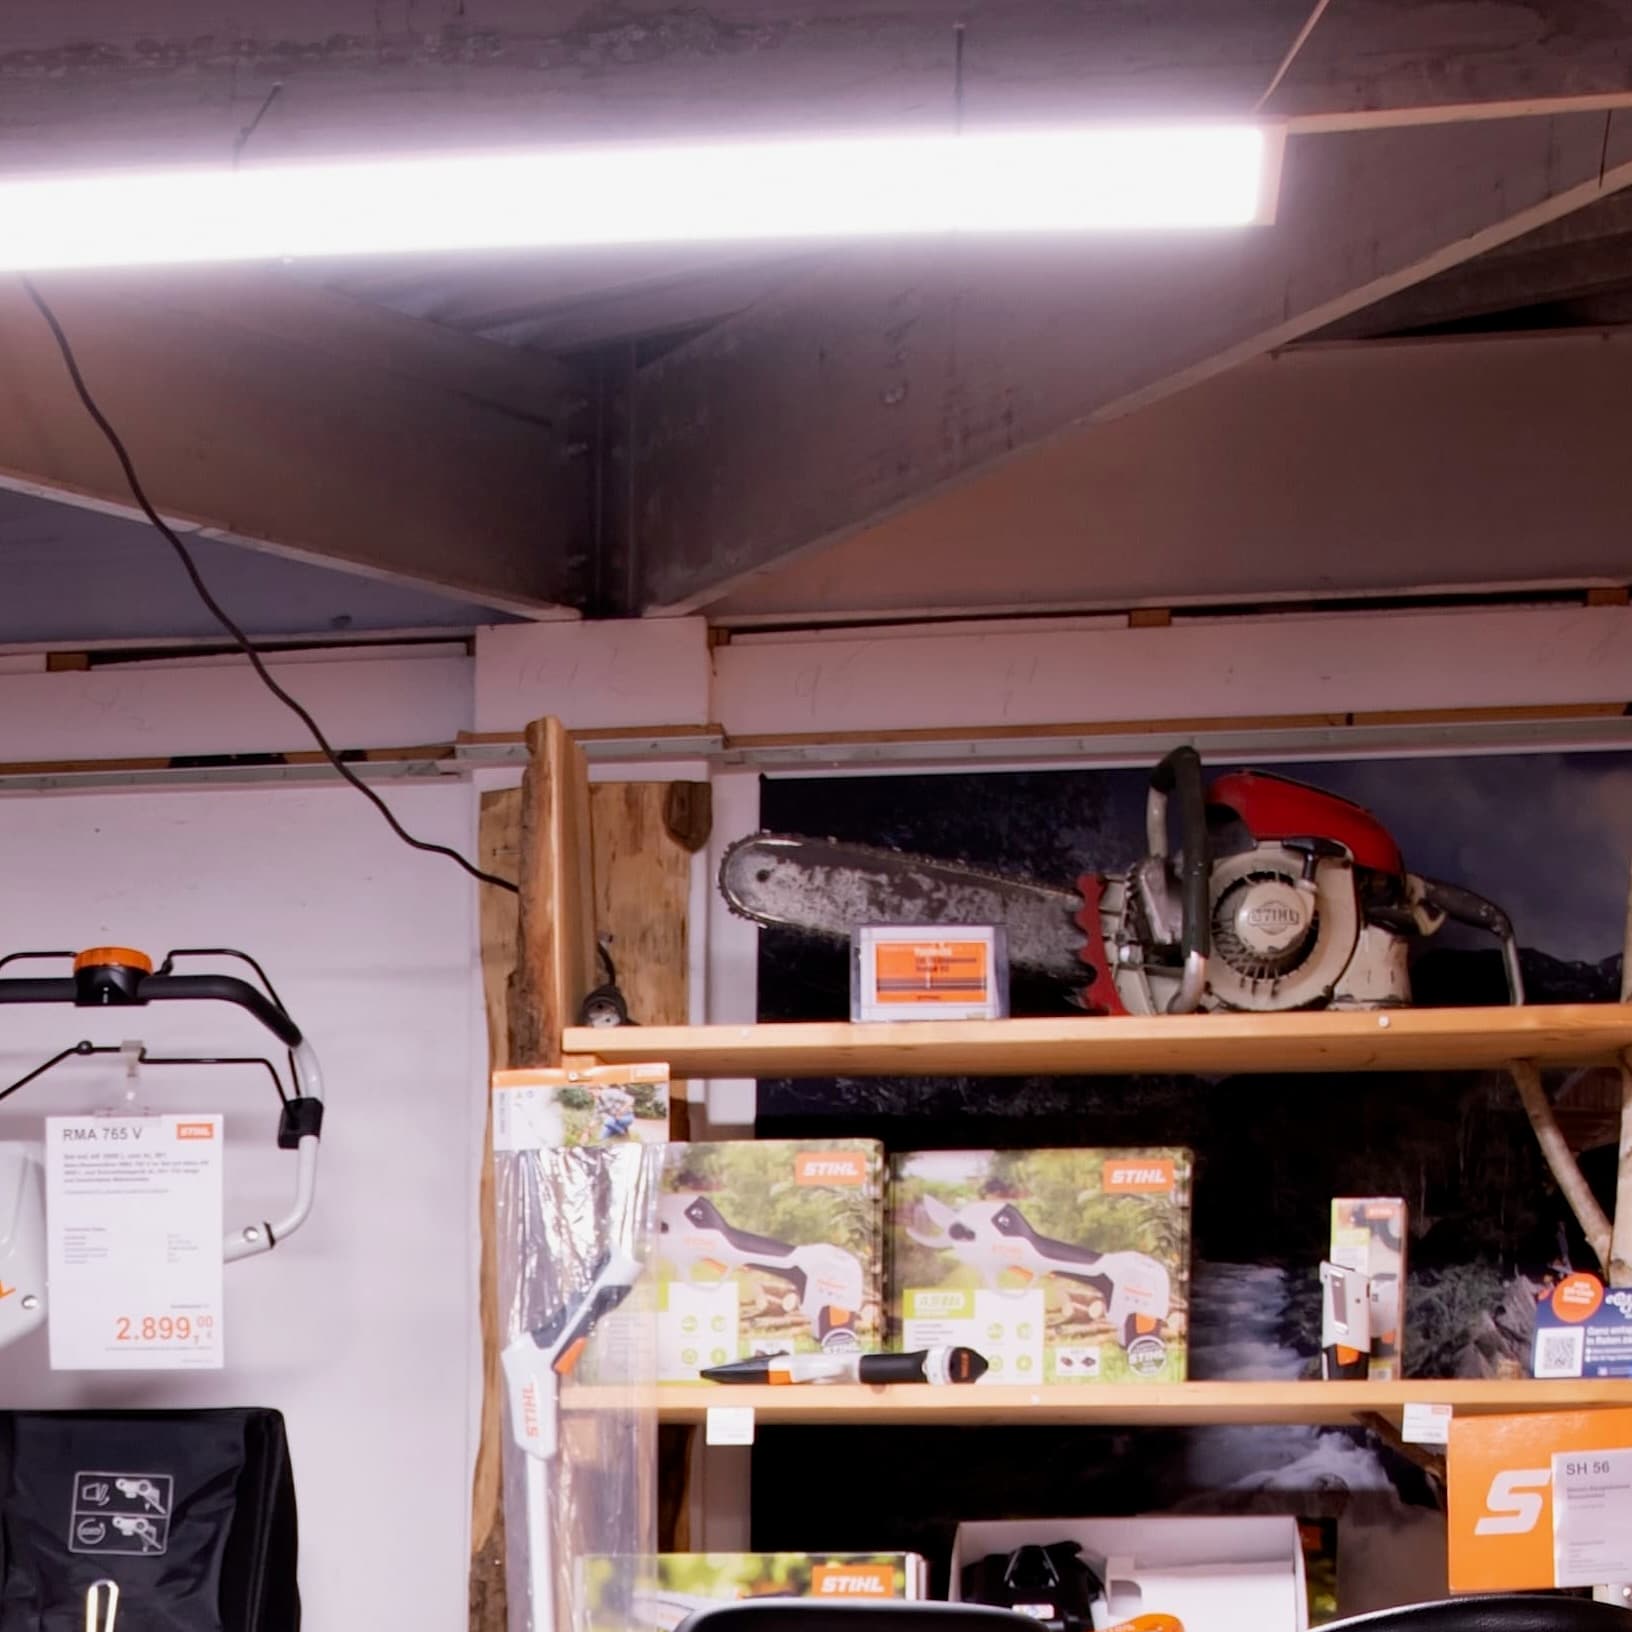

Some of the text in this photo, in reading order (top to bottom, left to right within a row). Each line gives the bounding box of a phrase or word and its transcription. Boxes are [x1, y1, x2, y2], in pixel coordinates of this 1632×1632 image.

[1250, 907, 1297, 924] STIHL
[63, 1127, 143, 1141] RMA 765 V
[803, 1161, 858, 1177] STIHL
[1110, 1168, 1167, 1185] STIHL
[522, 1383, 538, 1438] STIHL
[1566, 1460, 1610, 1476] SH 56
[820, 1575, 885, 1594] STIHL
